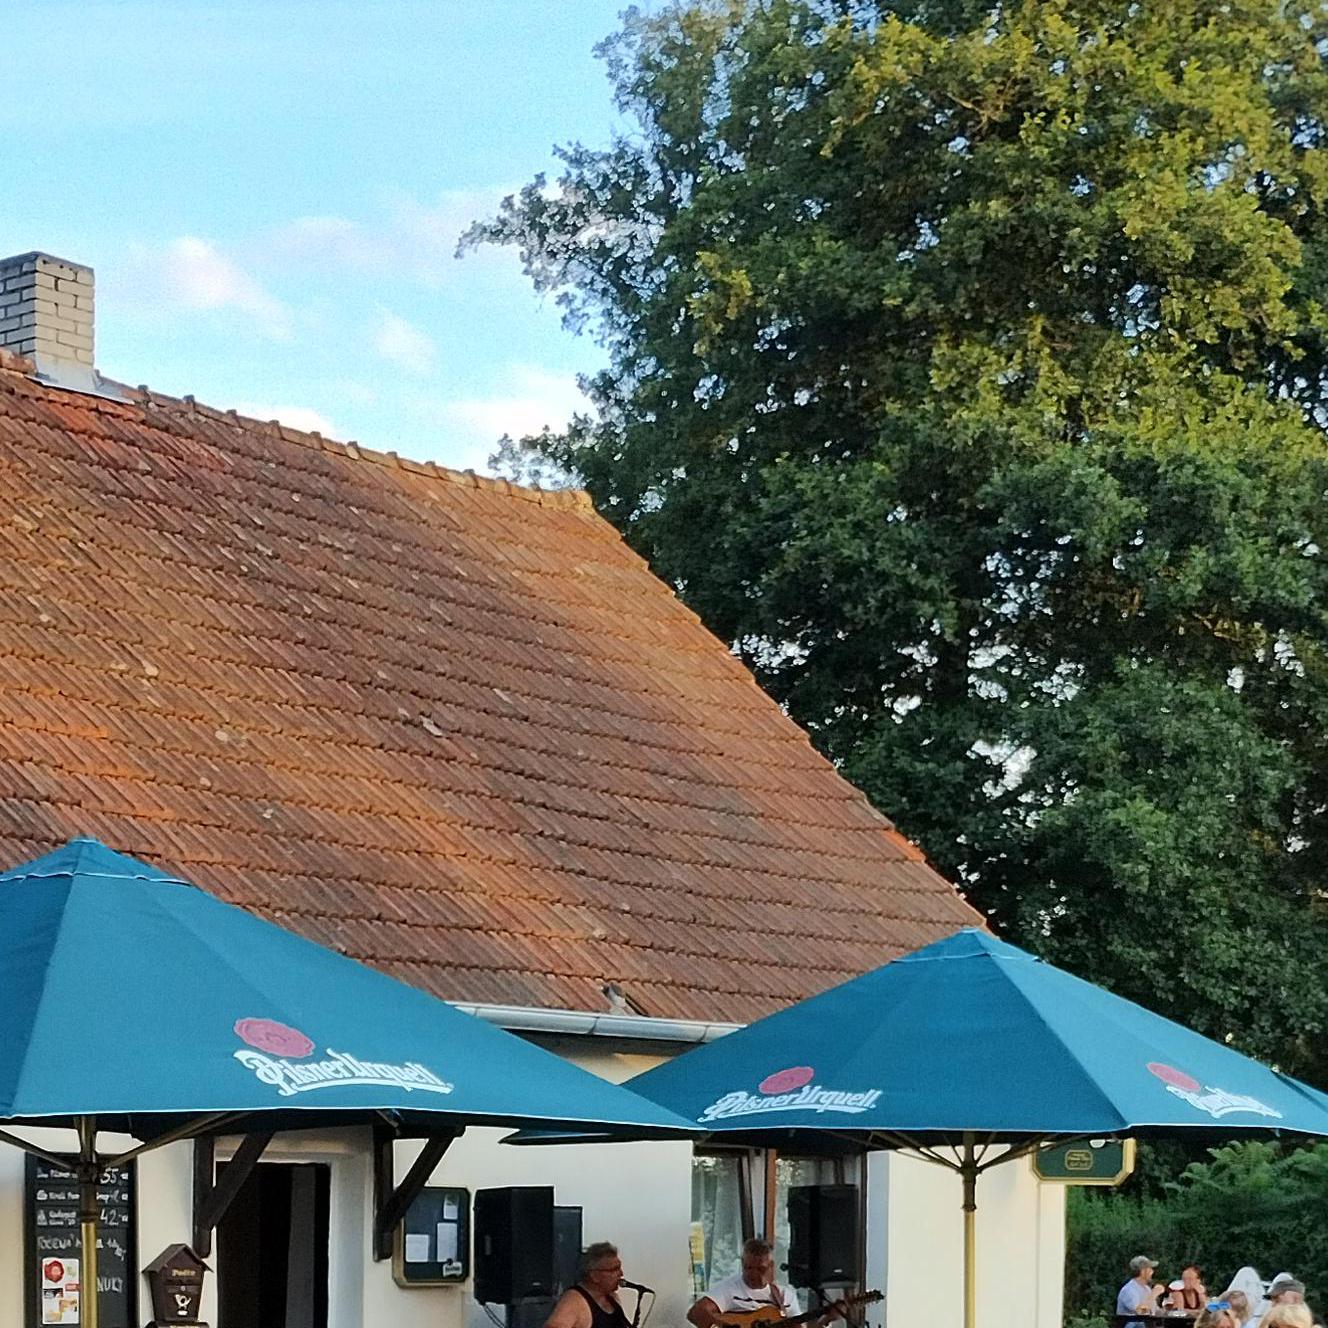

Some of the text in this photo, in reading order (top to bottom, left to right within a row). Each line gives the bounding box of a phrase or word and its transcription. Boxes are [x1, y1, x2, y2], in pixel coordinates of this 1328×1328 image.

[233, 1048, 454, 1096] Pilsner Urquell
[697, 1085, 883, 1122] Pilsner Urquell
